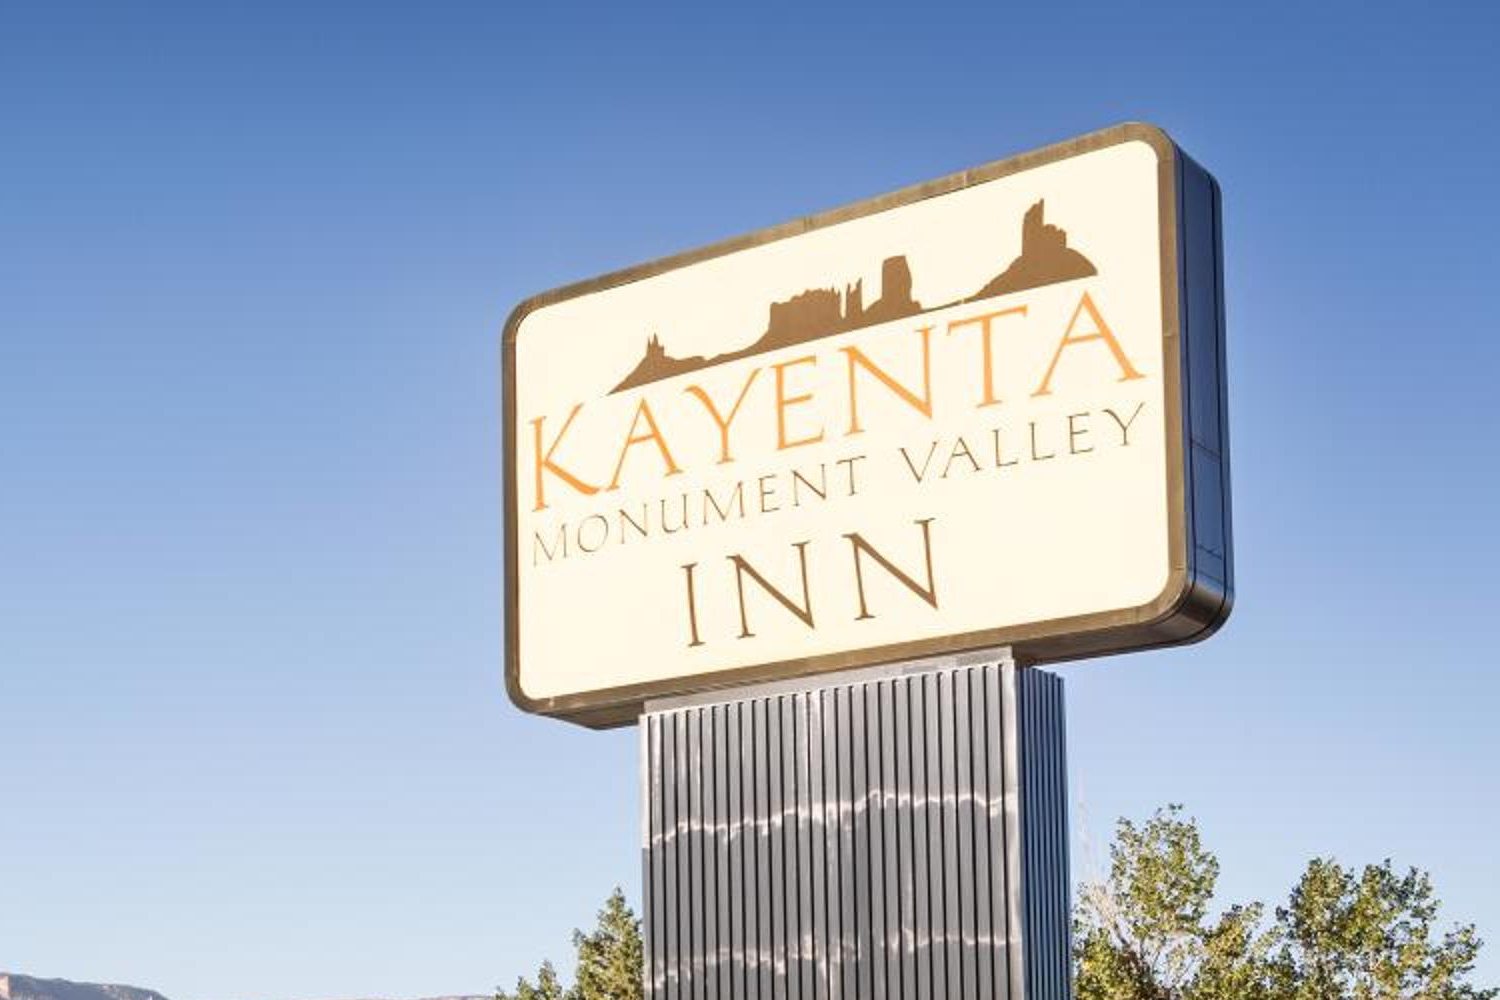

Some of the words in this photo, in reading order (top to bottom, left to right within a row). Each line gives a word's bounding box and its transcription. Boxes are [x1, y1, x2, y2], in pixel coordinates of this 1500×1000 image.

[530, 290, 1146, 511] KAYENTA
[533, 455, 868, 566] MONUMENT
[899, 403, 1146, 484] VALLEY
[680, 517, 940, 648] INN
